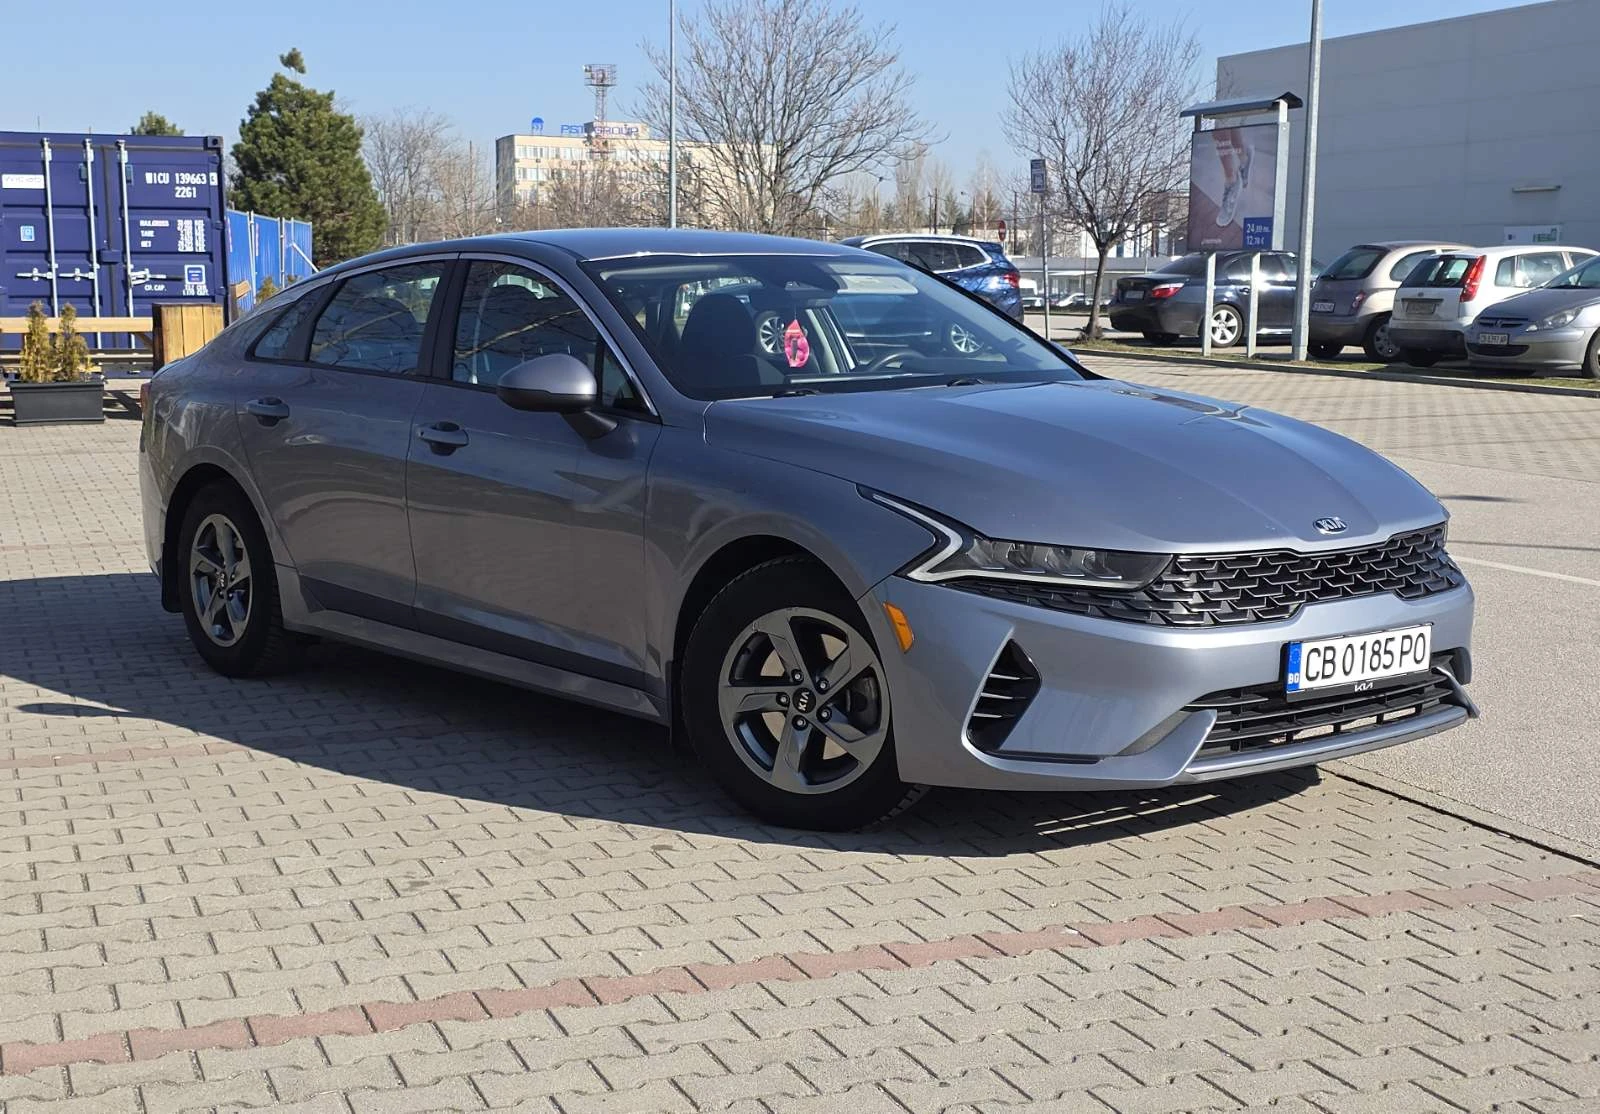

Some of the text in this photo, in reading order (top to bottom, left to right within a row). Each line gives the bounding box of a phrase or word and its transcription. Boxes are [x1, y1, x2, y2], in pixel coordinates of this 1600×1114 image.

[175, 172, 207, 185] 139663
[175, 186, 197, 198] 22G1
[1318, 517, 1347, 532] KIA
[1305, 632, 1426, 681] CB 0185 PO
[1287, 672, 1300, 684] BG
[1354, 681, 1374, 692] KIA
[798, 691, 809, 711] KIA
